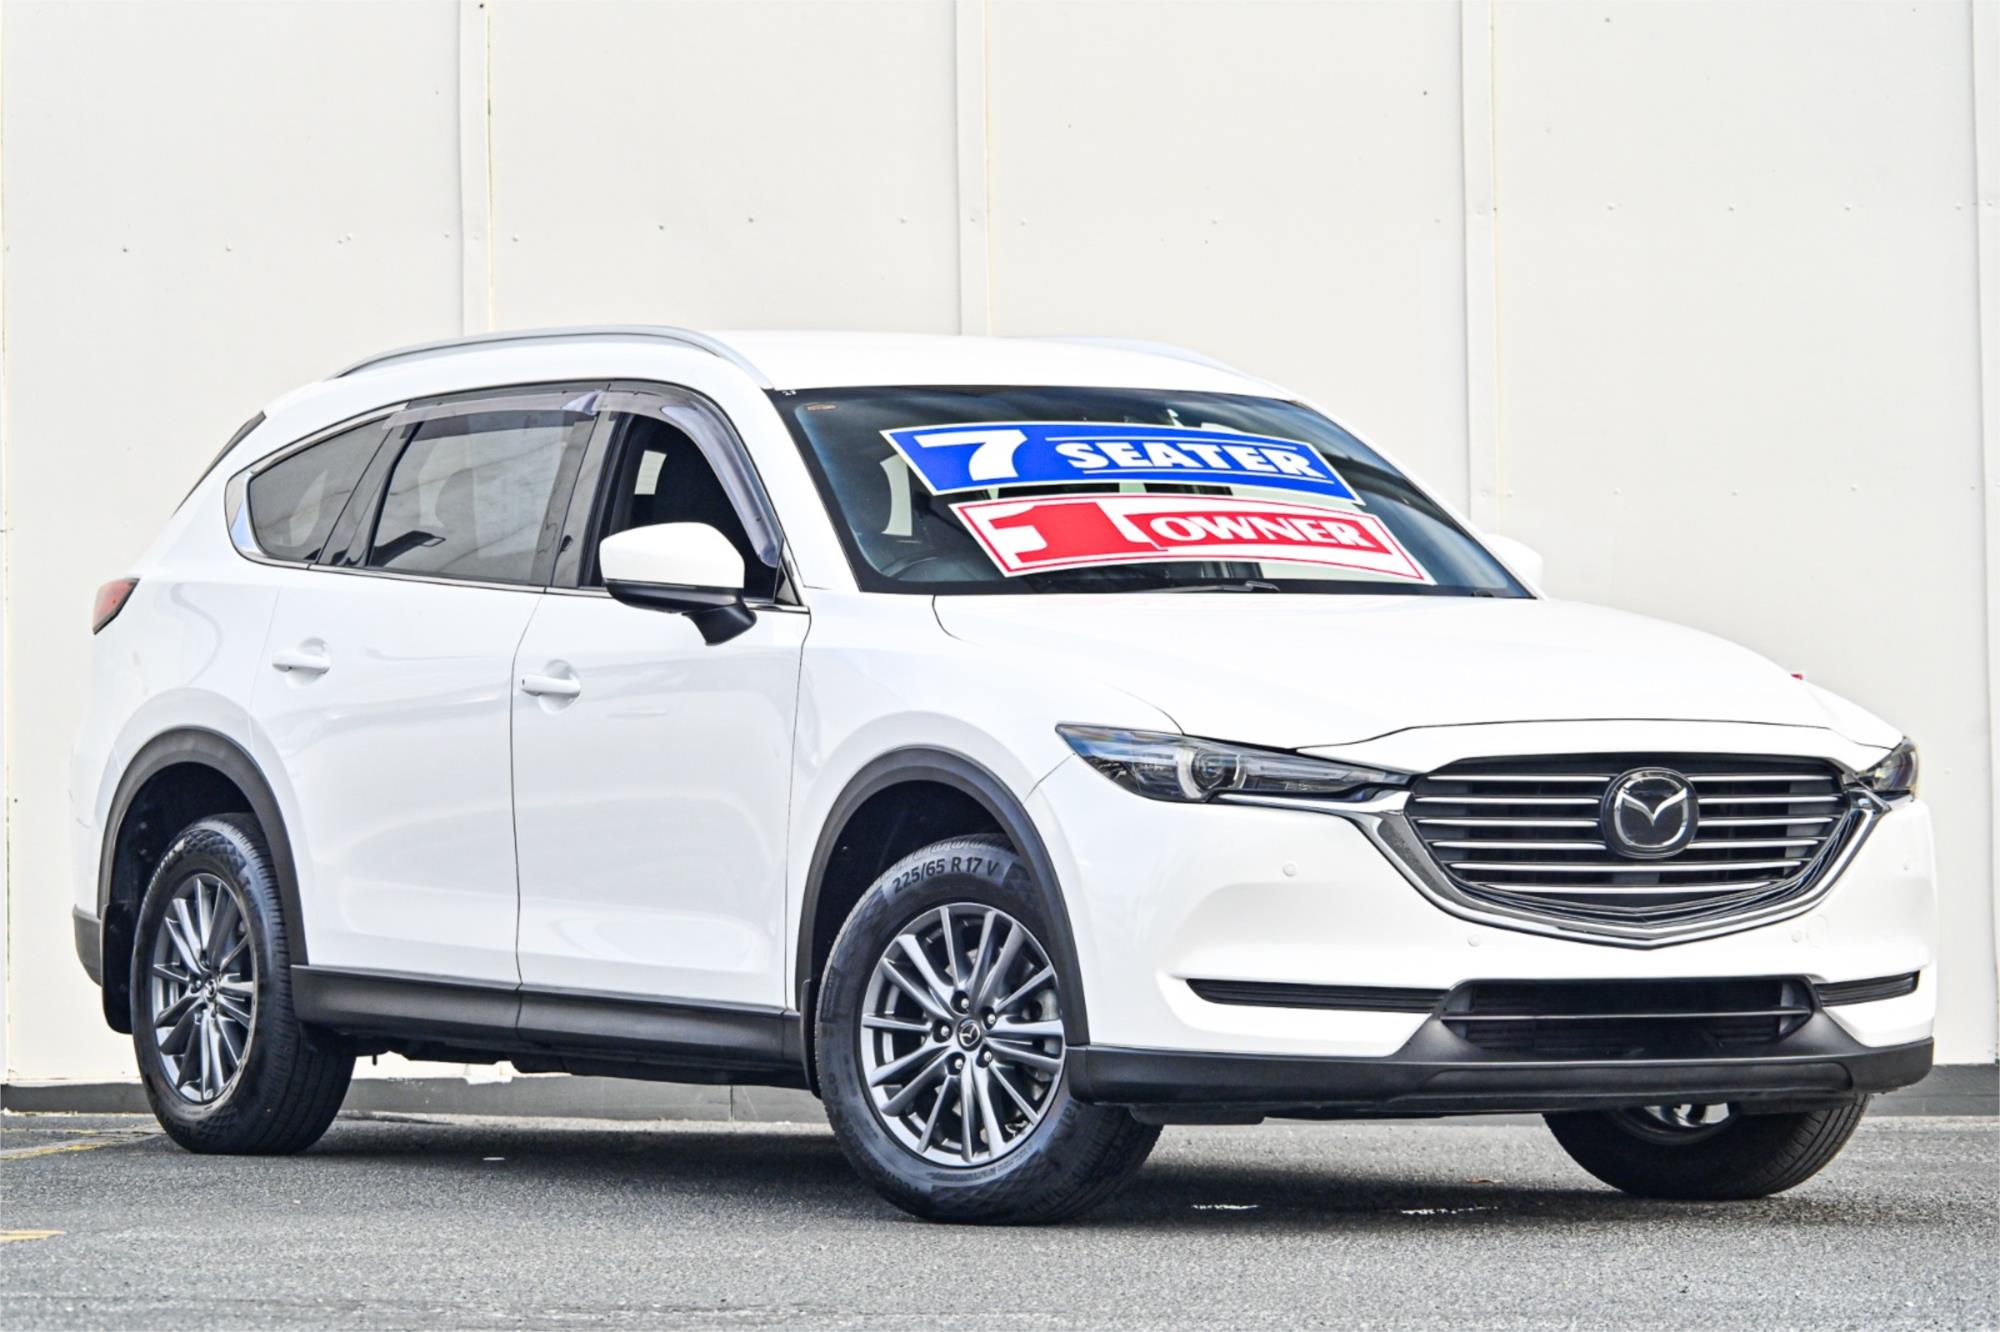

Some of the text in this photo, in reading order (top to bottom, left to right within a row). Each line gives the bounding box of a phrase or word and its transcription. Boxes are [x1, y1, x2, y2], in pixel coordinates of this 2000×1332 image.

[914, 430, 1316, 481] 7 SEATER
[989, 502, 1362, 563] 1 OWNER
[893, 856, 999, 893] 225/65 R 17 V
